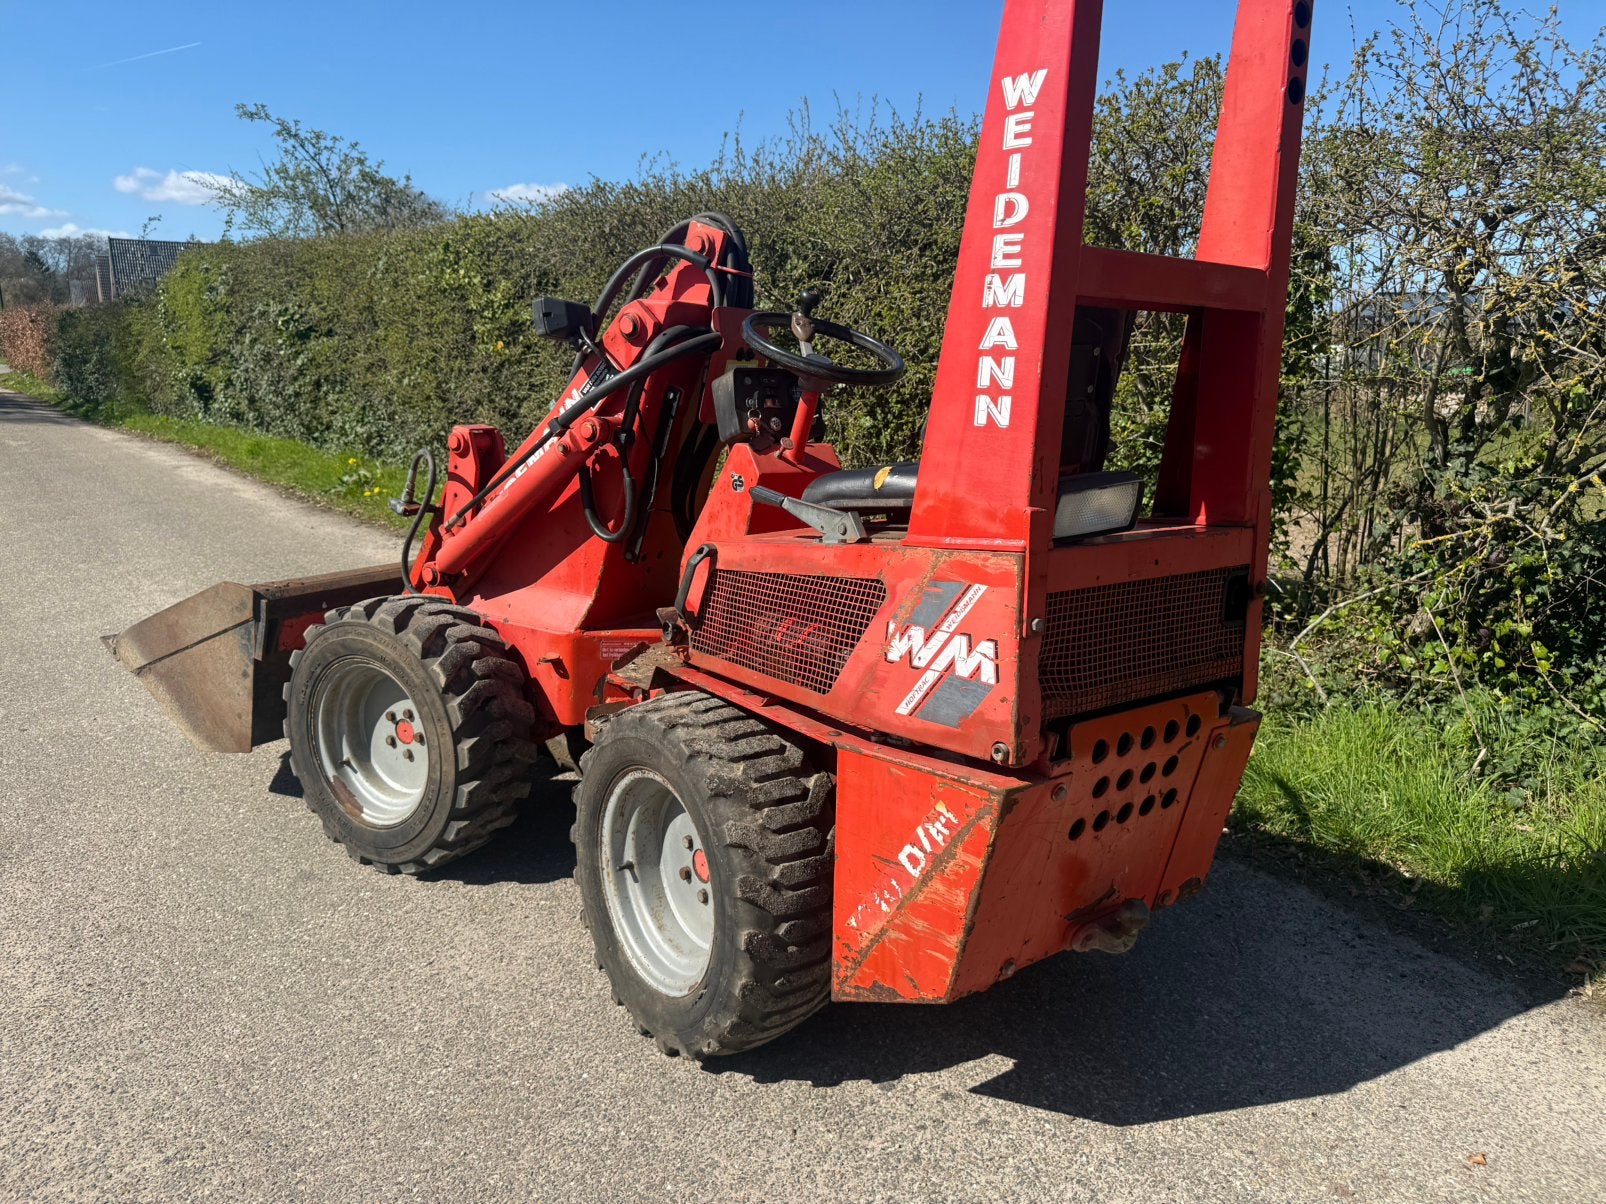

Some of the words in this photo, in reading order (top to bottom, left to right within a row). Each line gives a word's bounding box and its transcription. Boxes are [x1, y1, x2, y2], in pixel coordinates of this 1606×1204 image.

[973, 68, 1048, 428] WEIDEMANN
[885, 620, 999, 685] WM
[904, 677, 930, 707] HOFTRAC
